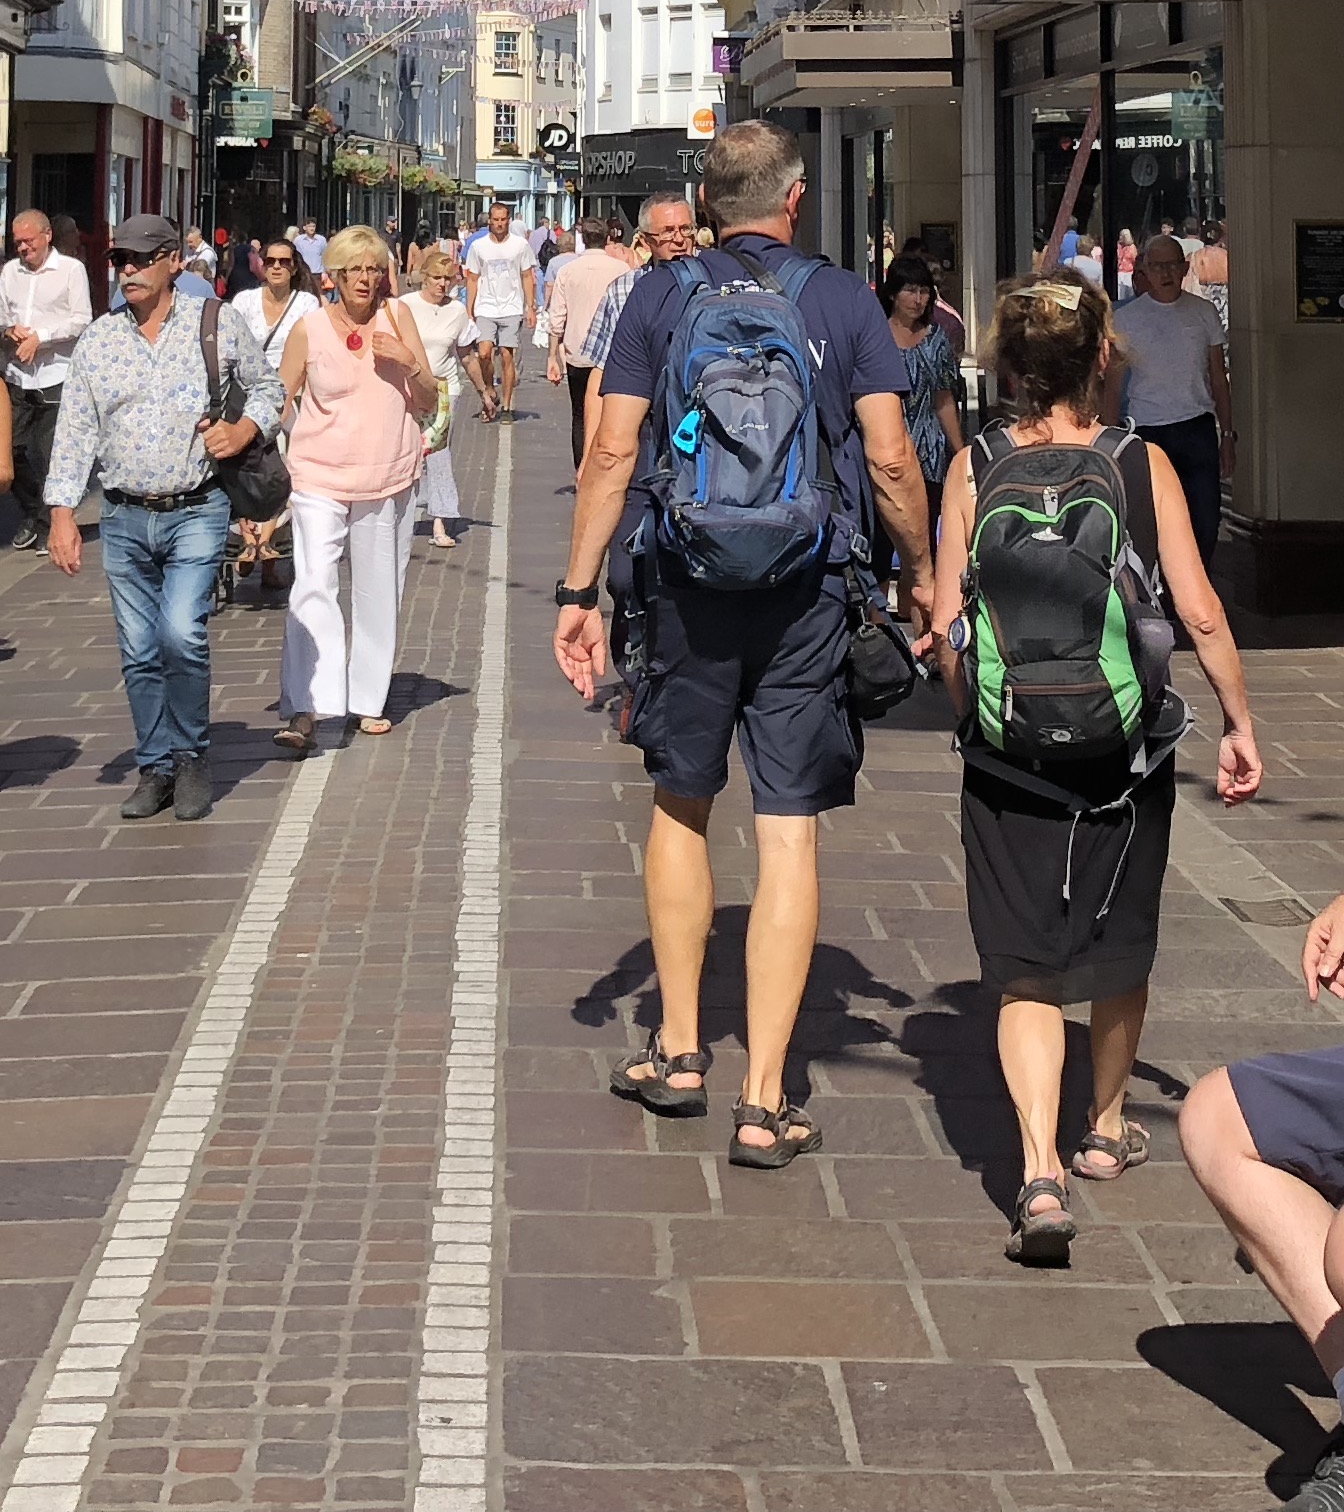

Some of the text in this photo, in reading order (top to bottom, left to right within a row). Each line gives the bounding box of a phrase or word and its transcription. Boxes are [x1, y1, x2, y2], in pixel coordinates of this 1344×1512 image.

[695, 119, 715, 127] sure
[544, 129, 569, 148] JD
[676, 148, 705, 175] TO
